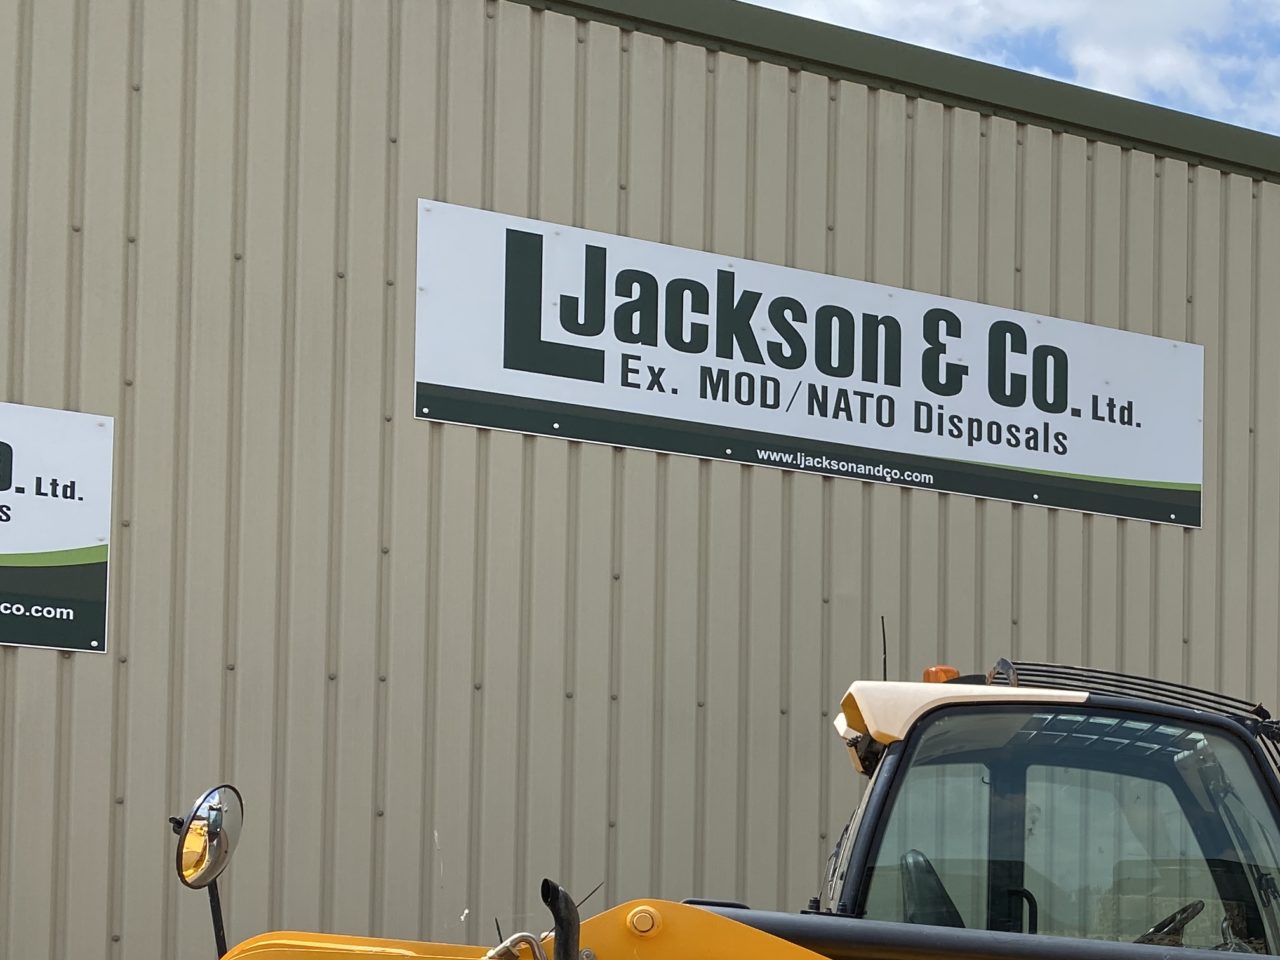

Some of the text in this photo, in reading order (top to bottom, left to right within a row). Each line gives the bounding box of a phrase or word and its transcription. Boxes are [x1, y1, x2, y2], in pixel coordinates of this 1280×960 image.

[922, 308, 969, 397] &
[988, 320, 1082, 418] Co.
[1091, 395, 1142, 427] Ltd.
[620, 353, 1068, 455] Ex. MOD/NATO Disposals
[35, 476, 84, 501] Ltd.
[756, 449, 934, 484] www.ljacksonandco.com
